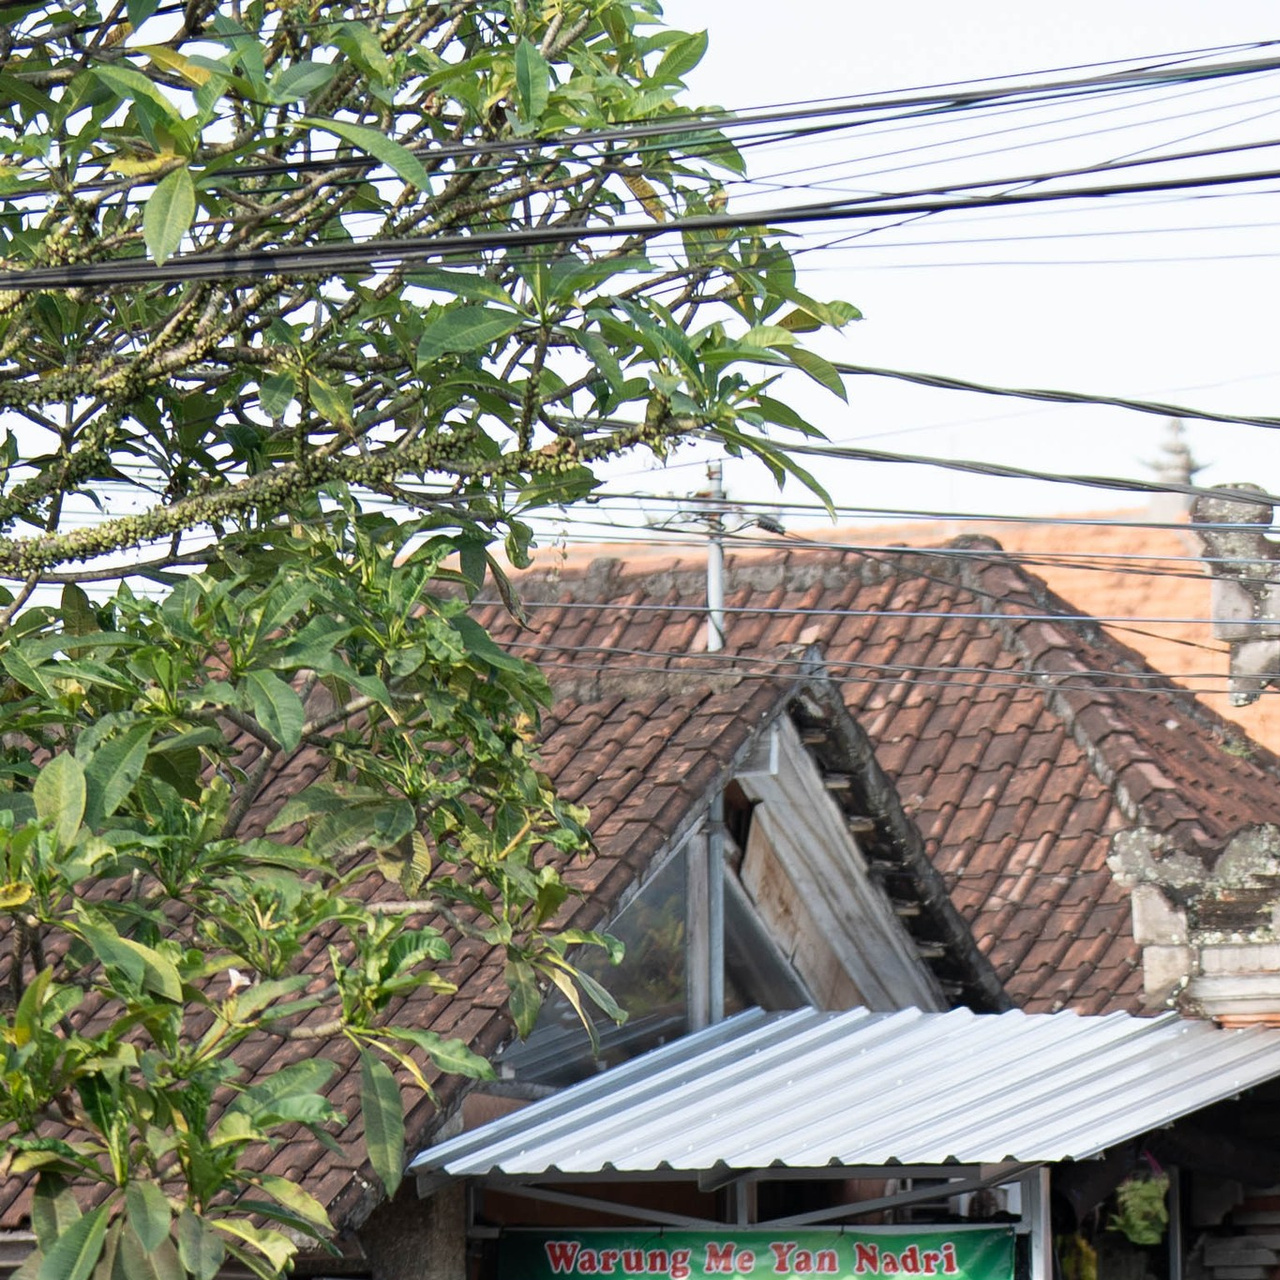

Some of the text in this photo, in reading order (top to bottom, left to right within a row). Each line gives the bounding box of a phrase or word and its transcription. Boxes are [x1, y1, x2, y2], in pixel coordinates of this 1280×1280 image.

[546, 1242, 960, 1280] Warung Me Yan Nadri
